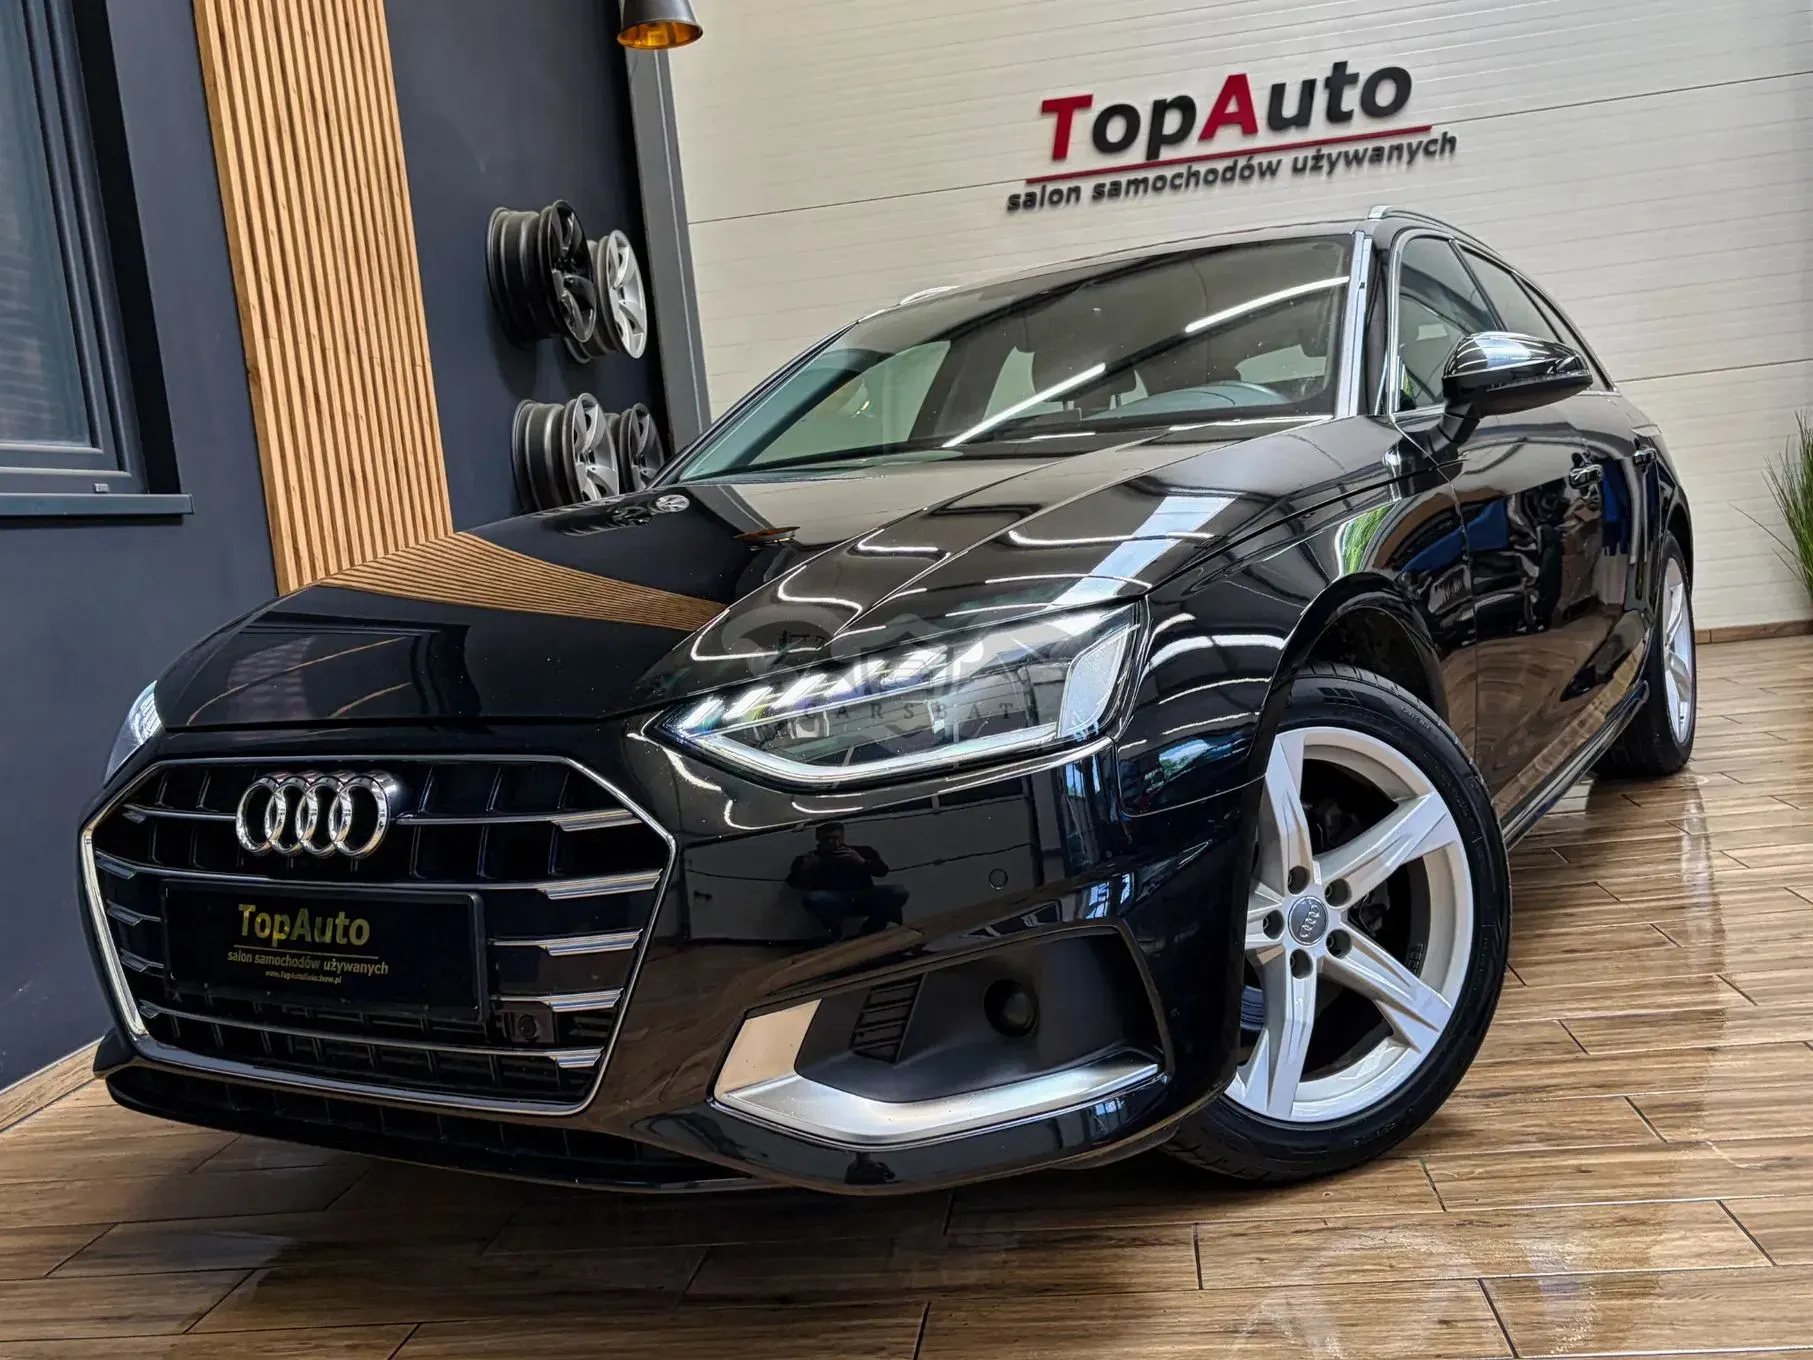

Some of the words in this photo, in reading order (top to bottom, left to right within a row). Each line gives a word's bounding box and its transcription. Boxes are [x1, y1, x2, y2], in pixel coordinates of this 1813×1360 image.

[1041, 61, 1412, 161] TopAuto
[1007, 185, 1081, 212] salon
[1091, 165, 1283, 201] samochodów
[1291, 133, 1457, 179] używanych
[238, 904, 371, 948] TopAuto
[227, 949, 252, 963] salon
[254, 954, 320, 970] samochodów
[324, 957, 389, 977] używanych
